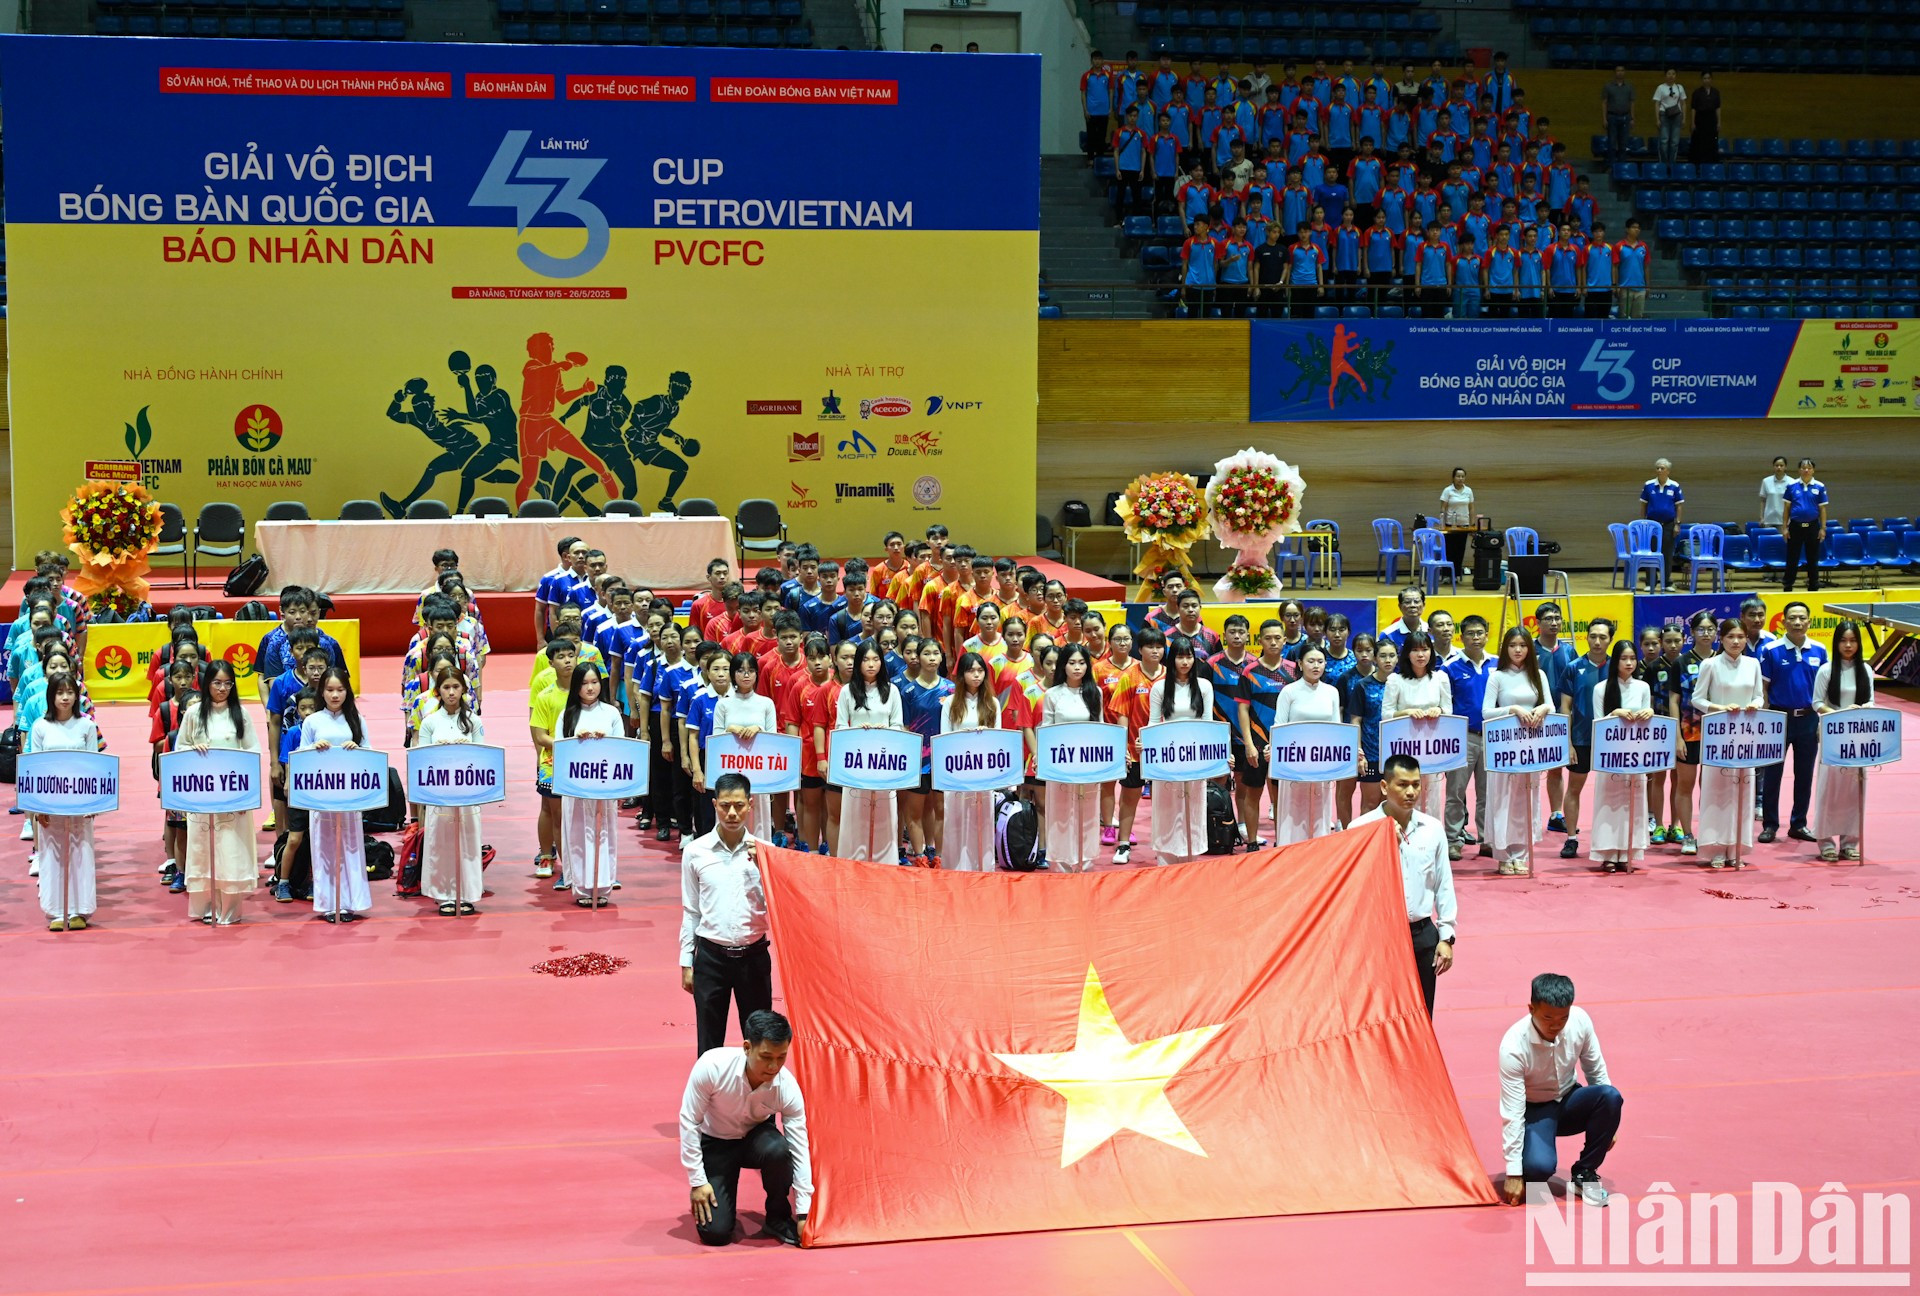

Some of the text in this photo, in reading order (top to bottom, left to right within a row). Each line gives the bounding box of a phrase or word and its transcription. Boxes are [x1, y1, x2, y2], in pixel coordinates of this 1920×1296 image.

[166, 74, 445, 91] SỞ VĂN HOÁ, THỂ THAO VÀ DU LỊCH THÀNH PHỐ ĐÀ NẴNG
[473, 80, 546, 93] BÁO NHÂN DÂN
[573, 80, 688, 96] CỤC THỂ DỤC THỂ THAO
[717, 84, 891, 100] LIÊN ĐOÀN BÓNG BÀN VIỆT NAM
[540, 138, 589, 150] LẦN THỨ
[204, 142, 433, 189] GIẢI VÔ ĐỊCH
[653, 158, 723, 185] CUP
[59, 182, 434, 224] BÓNG BÀN QUỐC GIA
[467, 130, 610, 279] 43
[653, 200, 913, 227] PETROVIETNAM
[163, 229, 434, 264] BÁO NHÂN DÂN
[654, 239, 764, 266] PVCFC
[469, 288, 480, 297] ĐÀ
[482, 288, 507, 299] NẴNG,
[510, 288, 521, 297] TỪ
[521, 288, 543, 298] NGÀY
[546, 290, 562, 298] 19/5
[570, 290, 610, 298] 26/5/2025
[124, 365, 283, 380] NHÀ ĐỒNG HÀNH CHÍNH
[825, 364, 905, 378] NHÀ TÀI TRỢ
[1476, 354, 1566, 374] GIẢI VÔ ĐỊCH
[1579, 338, 1636, 401] 43
[1652, 358, 1681, 370] CUP
[1420, 370, 1566, 389] BÓNG BÀN QUỐC GIA
[1651, 375, 1757, 387] PETROVIETNAM
[946, 401, 983, 410] VNPT
[1458, 389, 1565, 406] BÁO NHÂN DÂN
[1651, 392, 1697, 404] PVCFC
[888, 447, 942, 456] DOUBLE FISH
[90, 470, 138, 480] Chúc Mừng
[208, 454, 312, 476] PHÂN BÓN CÀ MAU
[216, 479, 302, 489] HẠT NGỌC MÙA VÀNG
[835, 482, 895, 498] Vinamilk
[787, 500, 817, 508] KAMITO
[1892, 640, 1918, 679] SPORT
[1488, 730, 1500, 743] CLB
[1501, 728, 1513, 745] ĐẠI
[1514, 727, 1527, 744] HỌC
[1605, 724, 1667, 744] CÂU LẠC BỘ
[1707, 721, 1783, 736] CLB P. 14, Q. 10
[1827, 719, 1896, 734] CLB TRÀNG AN
[1050, 744, 1114, 764] TÂY NINH
[1144, 741, 1228, 764] TP. HỒ CHÍ MINH
[1276, 741, 1351, 763] TIỀN GIANG
[1390, 737, 1460, 757] VĨNH LONG
[1494, 745, 1563, 768] PPP CÀ MAU
[1706, 738, 1782, 760] TP. HỒ CHÍ MINH
[1840, 739, 1881, 761] HÀ NỘI
[719, 753, 788, 774] TRỌNG TÀI
[844, 747, 907, 771] ĐÀ NẴNG
[945, 749, 1011, 772] QUÂN ĐỘI
[1600, 751, 1670, 769] TIMES CITY
[172, 770, 249, 793] HƯNG YÊN
[293, 768, 382, 791] KHÁNH HÒA
[417, 763, 496, 787] LÂM ĐỒNG
[568, 759, 634, 784] NGHỆ AN
[18, 770, 116, 795] HẢI DƯƠNG-LONG HẢI
